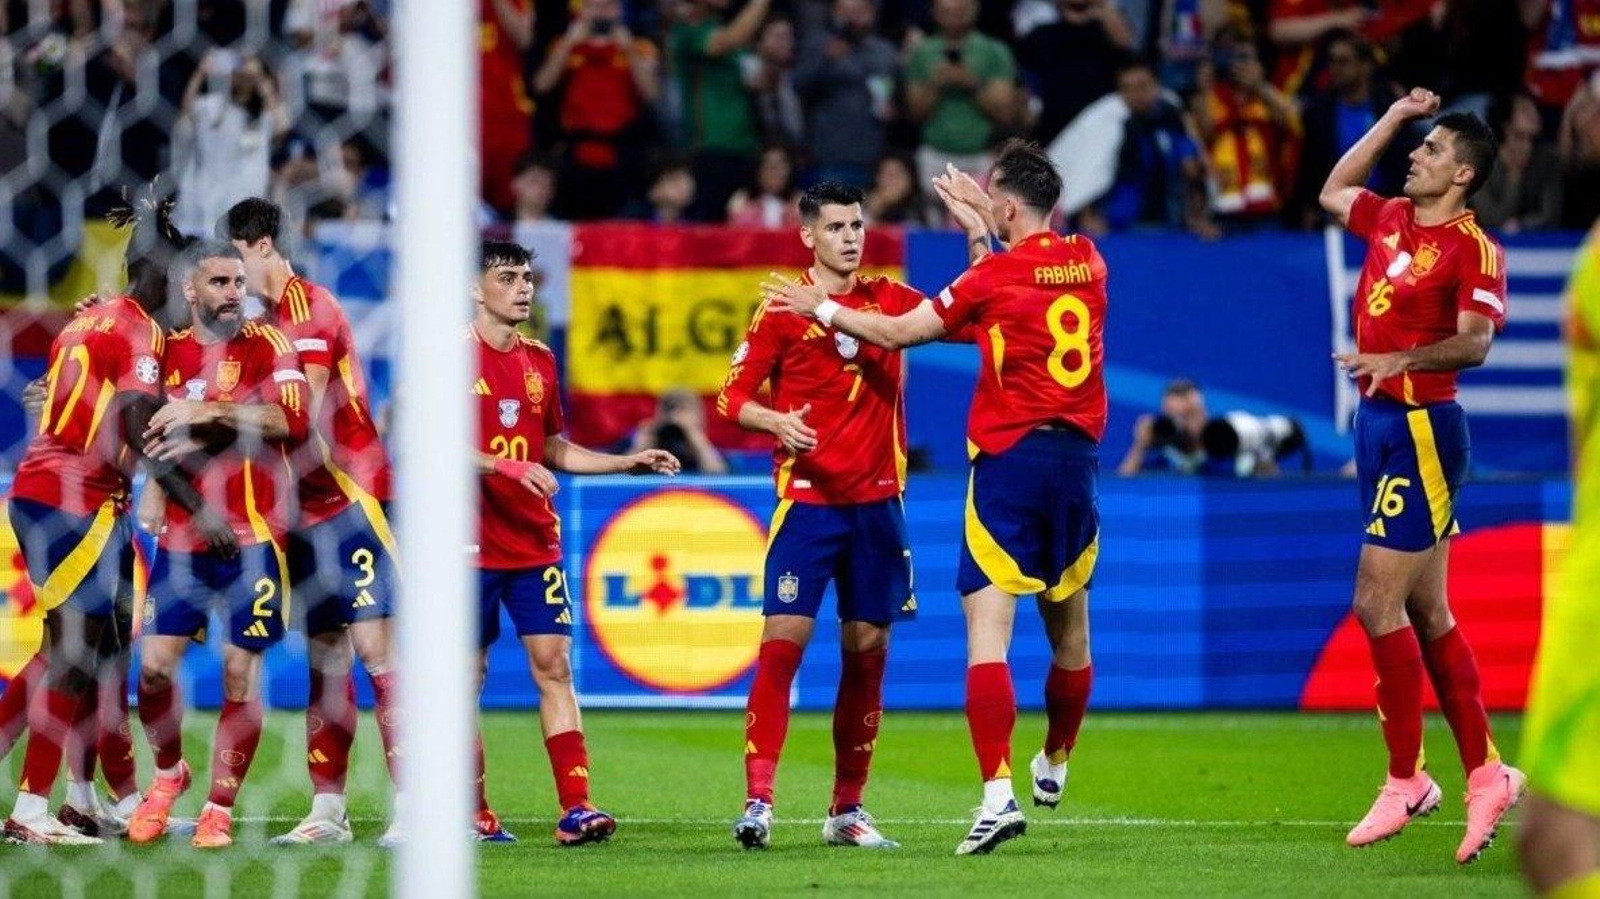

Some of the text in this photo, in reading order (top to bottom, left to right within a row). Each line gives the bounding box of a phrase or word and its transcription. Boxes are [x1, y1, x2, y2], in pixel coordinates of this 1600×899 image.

[1034, 261, 1092, 284] FABIÁN
[1045, 293, 1092, 389] 8
[39, 343, 90, 436] 17
[843, 363, 863, 402] 7
[489, 435, 529, 462] 20
[1372, 474, 1410, 518] 16
[351, 548, 374, 588] 3
[252, 577, 275, 618] 2
